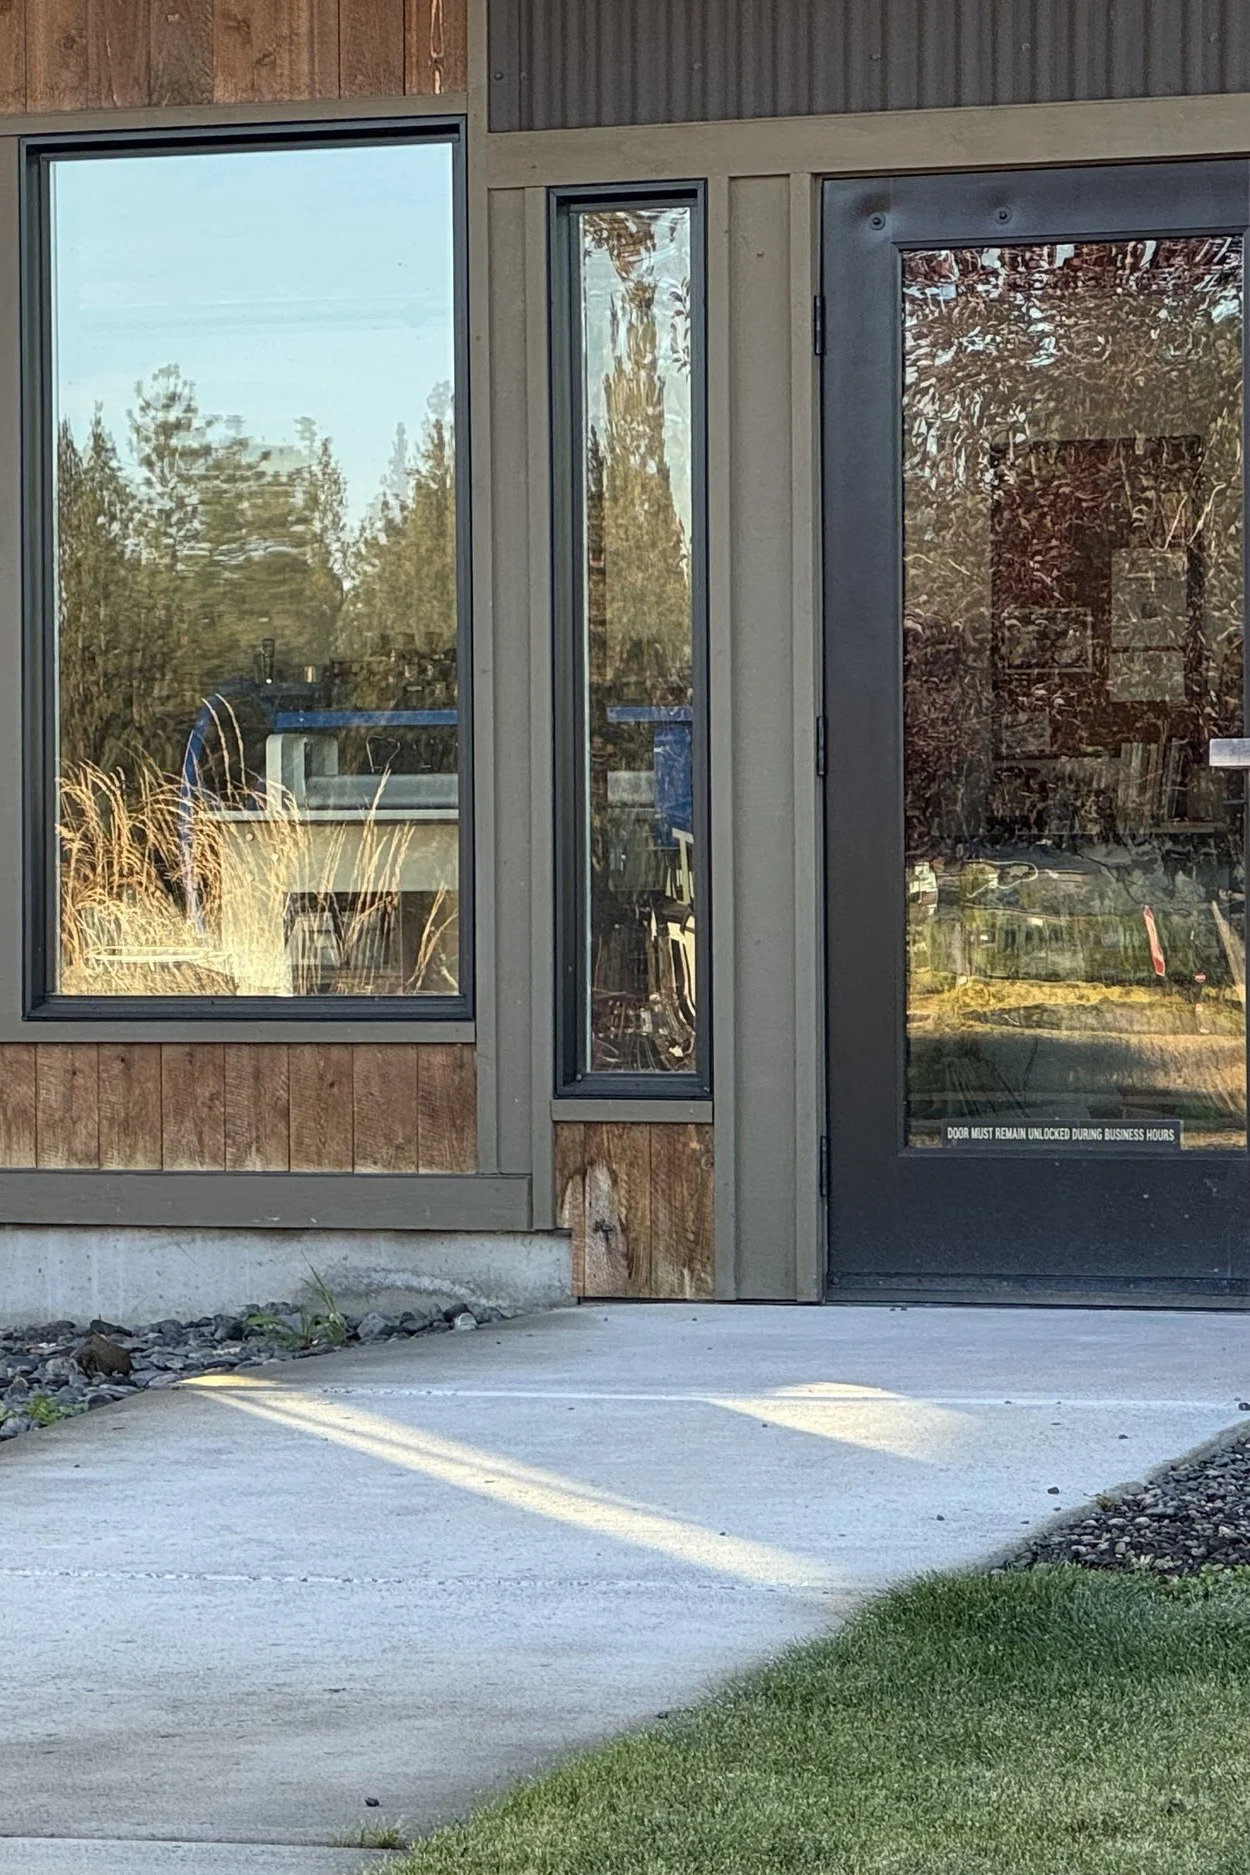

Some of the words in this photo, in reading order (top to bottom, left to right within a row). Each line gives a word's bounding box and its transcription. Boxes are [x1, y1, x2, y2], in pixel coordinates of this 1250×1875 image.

[947, 1127, 969, 1139] DOOR
[971, 1127, 993, 1139] MUST
[995, 1127, 1026, 1140] REMAIN
[1027, 1127, 1070, 1140] UNLOCKED
[1071, 1127, 1102, 1140] DURING
[1104, 1128, 1144, 1140] BUSINESS
[1146, 1128, 1174, 1141] HOURS
